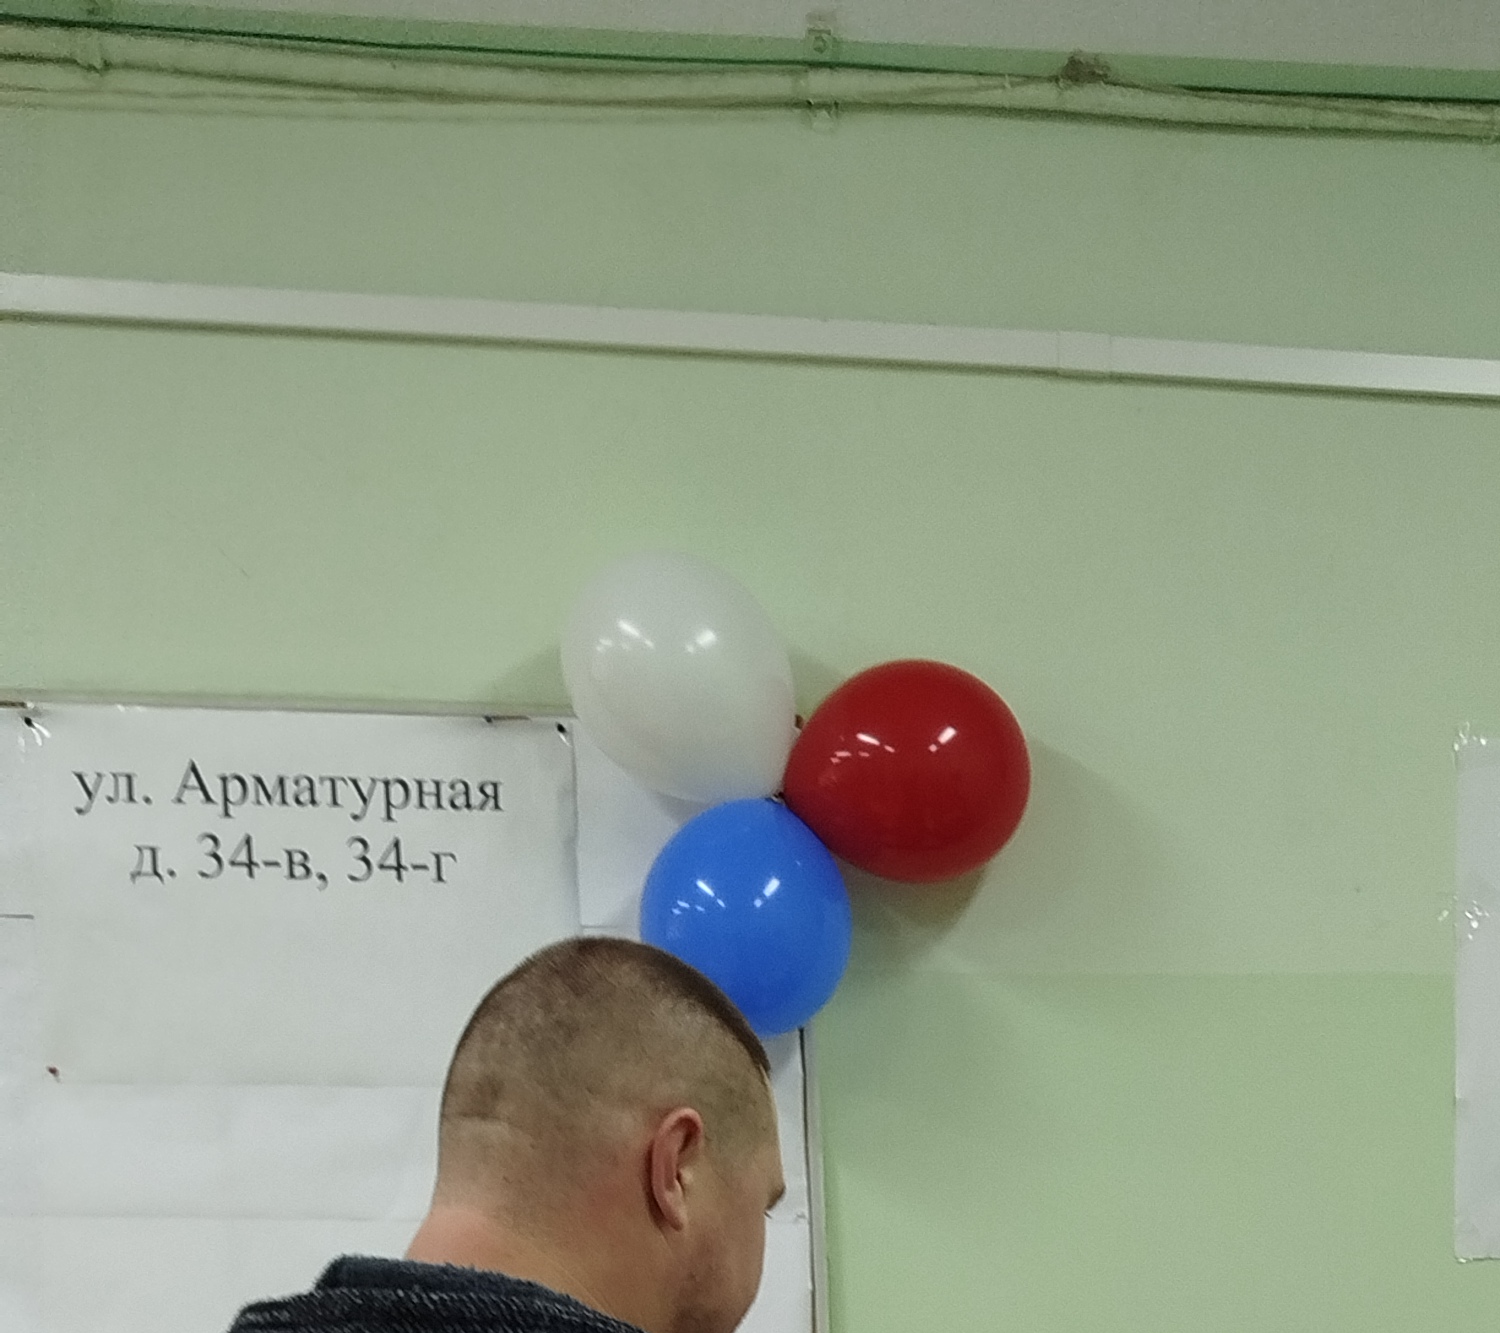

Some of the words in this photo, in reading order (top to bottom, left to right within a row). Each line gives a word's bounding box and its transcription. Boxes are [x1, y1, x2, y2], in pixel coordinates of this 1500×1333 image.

[72, 769, 154, 816] ул.
[171, 758, 506, 824] Арматурная
[128, 844, 177, 886] д.
[196, 831, 330, 890] 34-в,
[345, 834, 459, 885] 34-г
